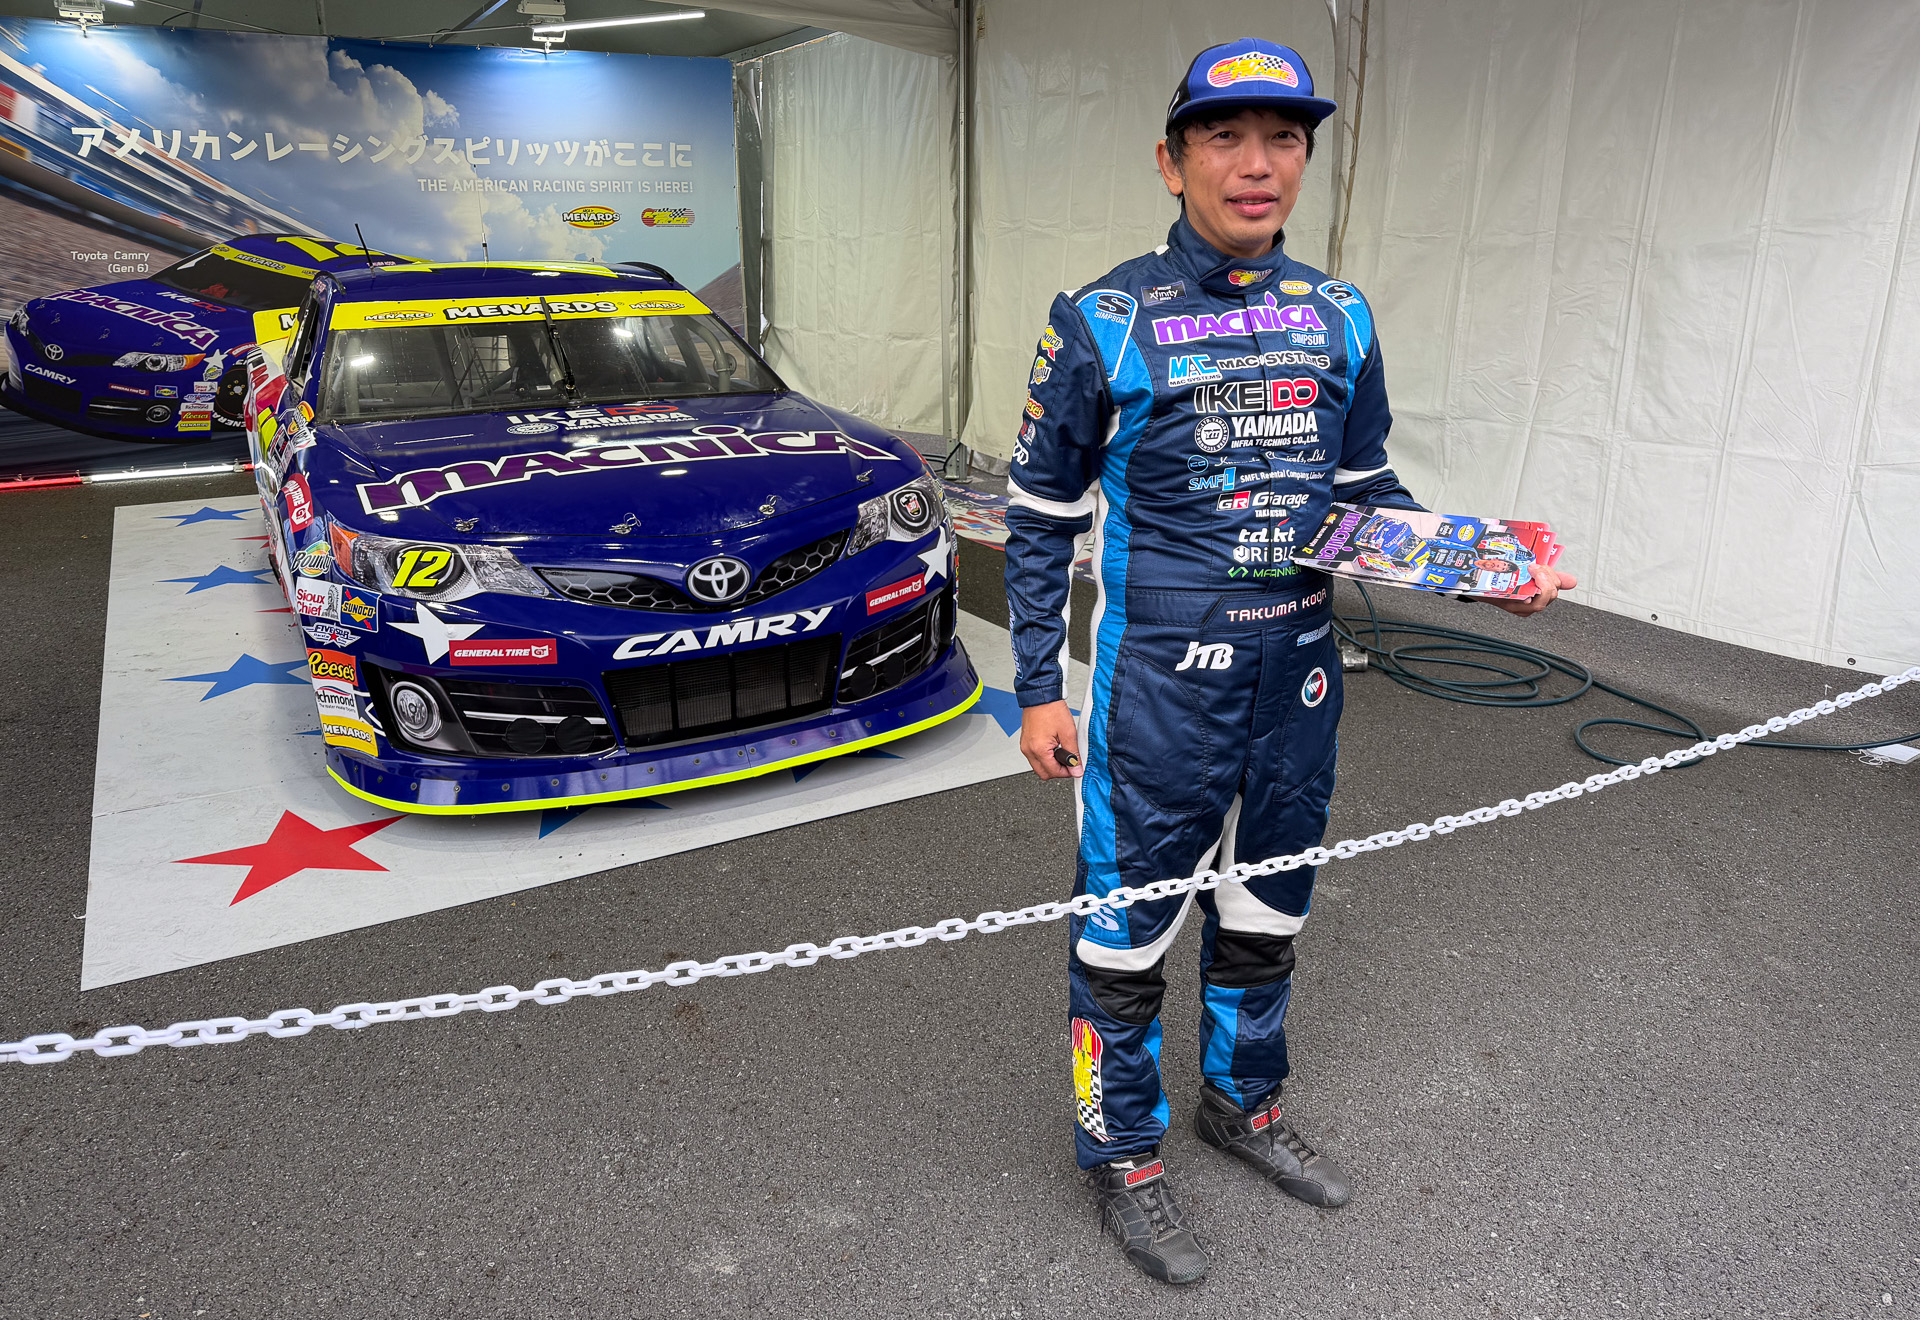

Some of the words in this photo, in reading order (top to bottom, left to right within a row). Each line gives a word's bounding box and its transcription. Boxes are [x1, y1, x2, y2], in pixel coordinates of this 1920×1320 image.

[71, 126, 693, 168] アメリカンレーシングスピリッツがここに
[417, 178, 447, 192] THE
[452, 178, 529, 193] AMERICAN
[532, 180, 585, 193] RACING
[590, 180, 633, 193] SPIRIT
[637, 181, 651, 193] IS
[655, 181, 693, 193] HERE!
[562, 211, 621, 222] MENARDS
[71, 251, 108, 262] Toyota
[113, 251, 150, 262] Camry
[234, 253, 286, 271] MENARDS
[107, 263, 134, 273] (Gen
[137, 263, 149, 273] 6)
[156, 291, 227, 312] IKEDO
[1149, 289, 1178, 300] xfinity
[364, 310, 434, 322] MENARDS
[445, 300, 618, 321] MENARDS
[1094, 311, 1126, 325] SIMPSON
[1291, 333, 1325, 345] SIMPSON
[1218, 355, 1258, 370] MAC
[1265, 352, 1330, 369] SYSTEMS
[24, 363, 77, 385] CAMRY
[1194, 377, 1319, 413] IKEDO
[506, 405, 679, 424] IKEDO
[556, 411, 693, 427] YAMADA
[1231, 439, 1254, 448] INFRA
[1188, 474, 1234, 491] SMFL
[1240, 472, 1260, 484] SMFL
[1218, 497, 1248, 510] GR
[291, 549, 335, 572] Bounty
[391, 550, 453, 588] 12
[296, 588, 325, 605] Sioux
[869, 592, 899, 607] GENERAL
[899, 585, 913, 597] TIRE
[342, 598, 374, 618] SUNOCO
[1226, 600, 1297, 622] TAKUMA
[315, 624, 334, 633] FIVE
[612, 606, 834, 661] CAMRY
[454, 648, 505, 658] GENERAL
[505, 647, 531, 657] TIRE
[1175, 641, 1234, 671] JTB
[308, 651, 356, 681] Reese's
[322, 723, 373, 743] MENARDS
[1126, 1162, 1163, 1185] SIMPSON
